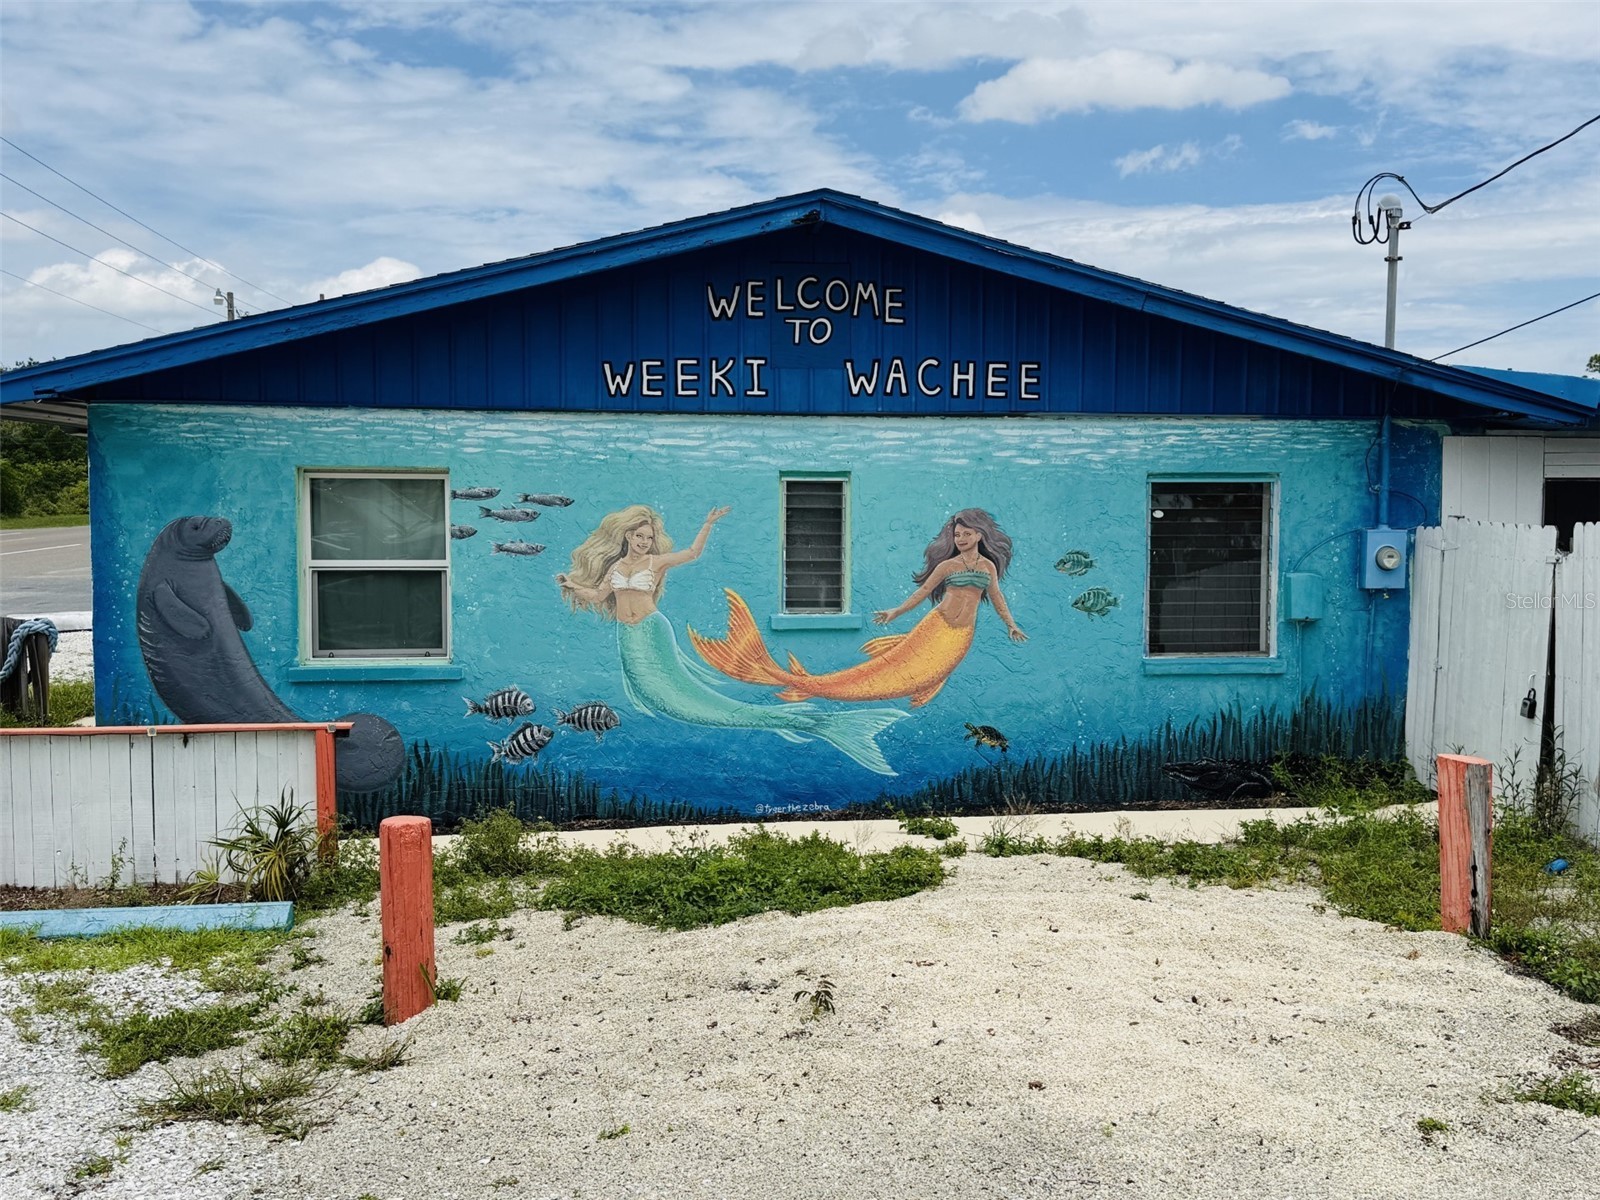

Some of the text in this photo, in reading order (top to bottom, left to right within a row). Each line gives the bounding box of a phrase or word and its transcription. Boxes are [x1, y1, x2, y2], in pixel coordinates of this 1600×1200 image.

[707, 276, 905, 324] WELCOME
[785, 317, 832, 344] TO
[603, 359, 1040, 399] WEEKI WACHEE
